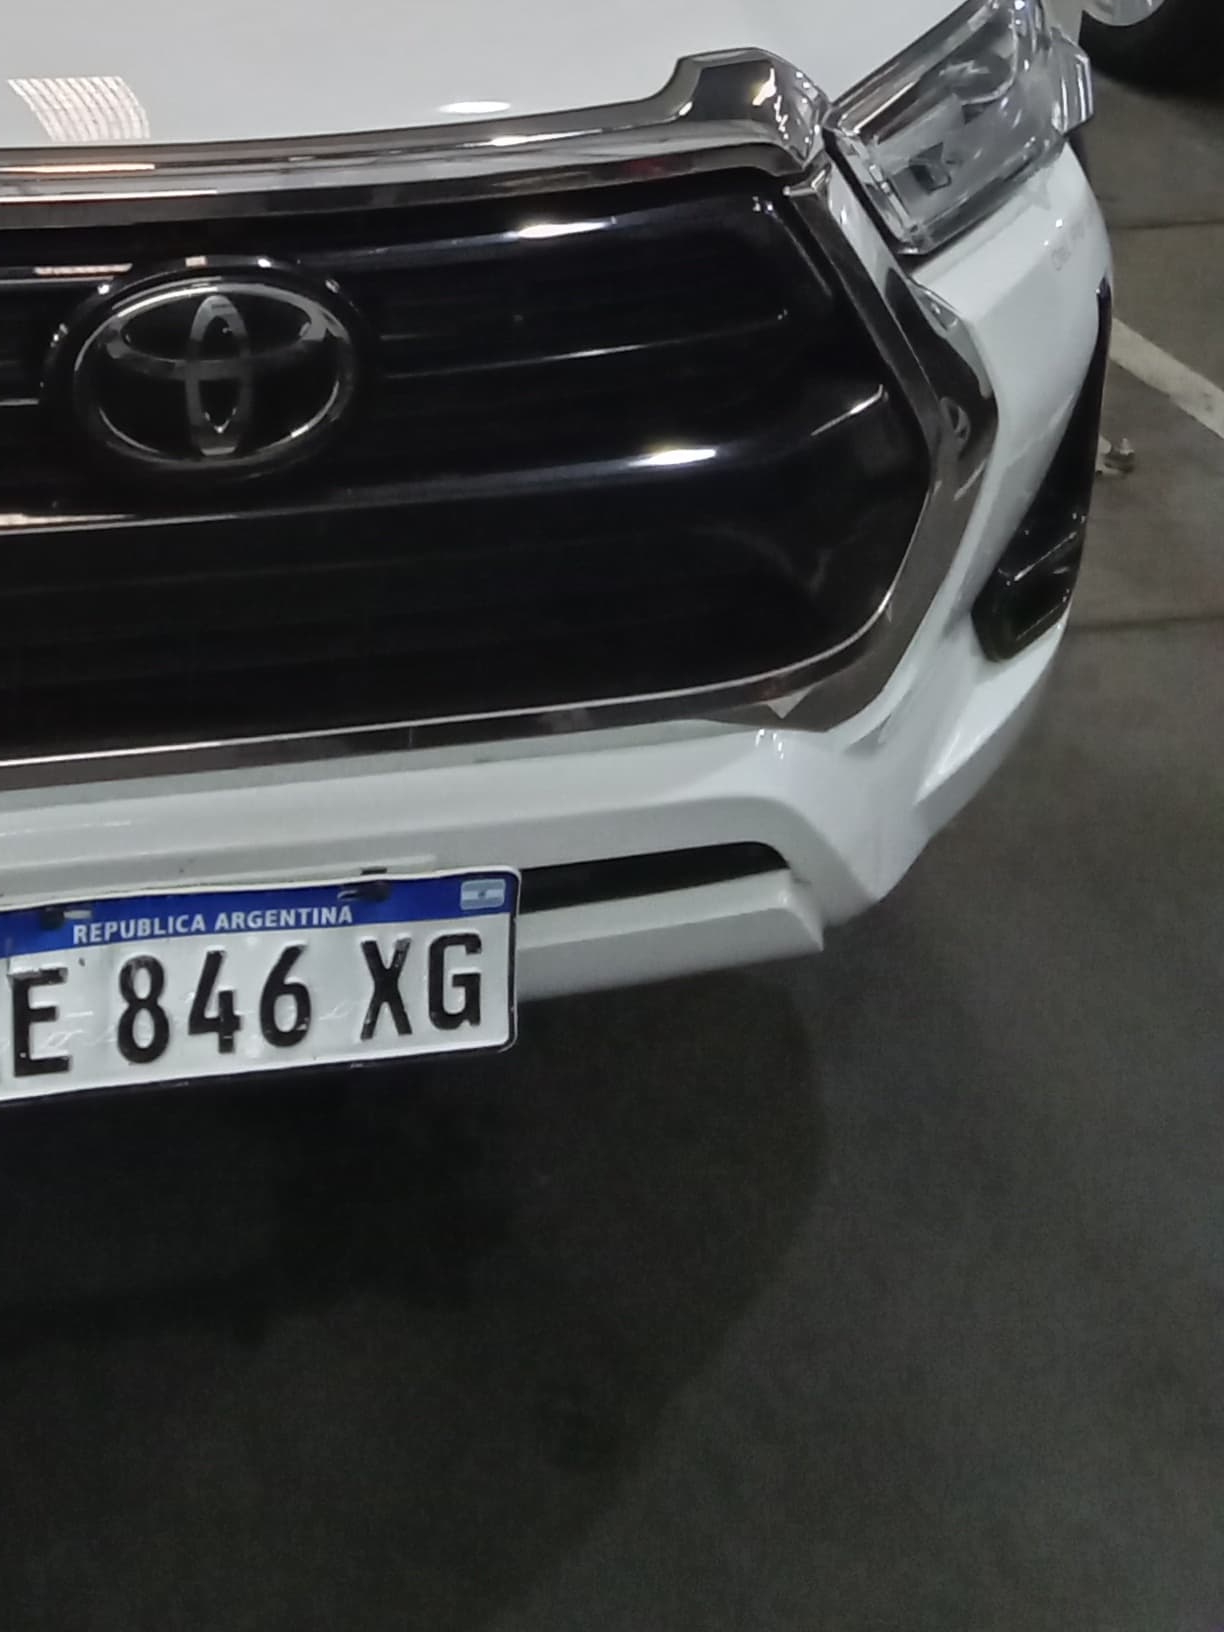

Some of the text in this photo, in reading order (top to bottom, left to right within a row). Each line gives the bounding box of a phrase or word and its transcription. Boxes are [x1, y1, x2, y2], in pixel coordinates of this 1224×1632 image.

[72, 905, 353, 945] REPUBLICA ARGENTINA
[116, 943, 312, 1066] 846
[359, 931, 484, 1042] XG
